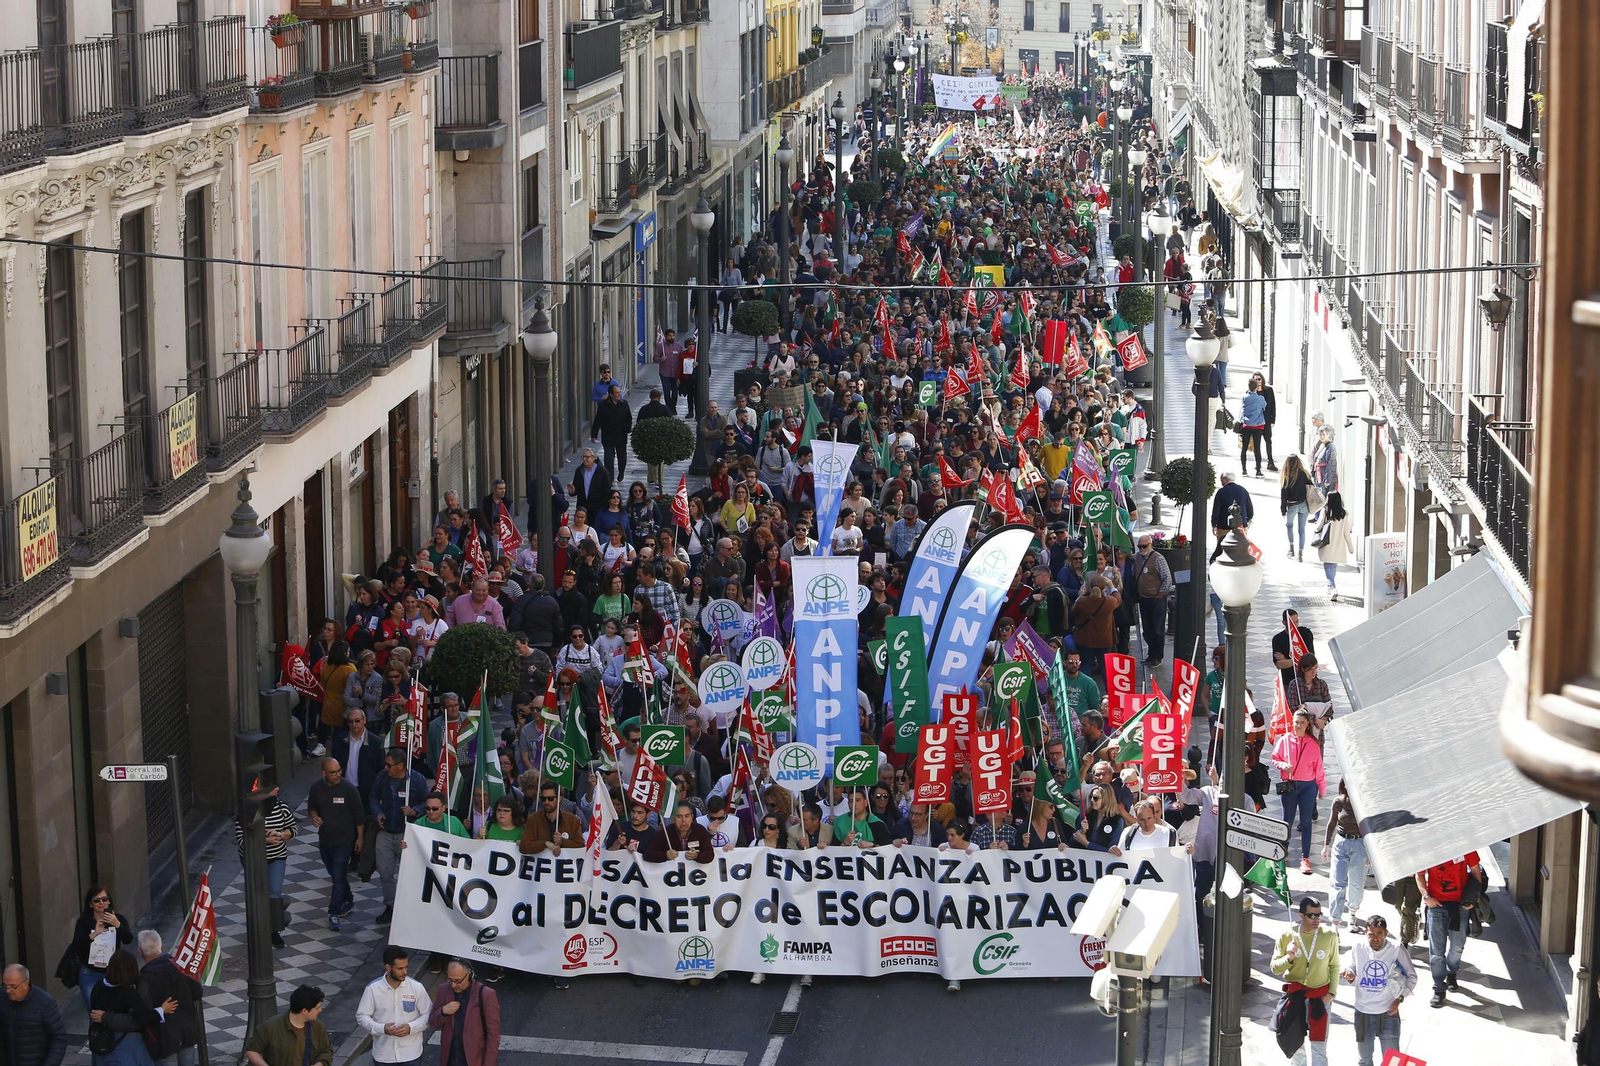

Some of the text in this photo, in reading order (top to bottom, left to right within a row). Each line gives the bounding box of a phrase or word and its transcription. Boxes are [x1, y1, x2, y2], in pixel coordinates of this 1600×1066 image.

[941, 79, 994, 89] CEIP GENIL
[171, 396, 195, 432] ALQUILER
[177, 425, 191, 446] EDIFICIO
[1115, 458, 1133, 466] CSIF
[22, 482, 55, 525] ALQUILER
[1089, 502, 1110, 511] CSIF
[29, 515, 50, 541] EDIFICIO
[24, 530, 57, 577] 696 470 900
[924, 545, 956, 562] ANPE
[1390, 550, 1404, 558] HOT
[972, 566, 1008, 583] ANPE
[803, 600, 850, 614] ANPE
[708, 620, 741, 632] ANPE
[746, 664, 781, 681] ANPE
[1003, 676, 1027, 689] CSIF
[1113, 657, 1131, 709] UGT
[705, 687, 745, 705] ANPE
[811, 628, 843, 764] ANPE
[1176, 665, 1196, 721] UGT
[949, 698, 970, 751] UGT
[650, 739, 680, 751] CSIF
[1151, 717, 1175, 771] UGT
[924, 728, 948, 782] UGT
[977, 733, 1003, 790] UGT
[551, 755, 571, 772] CSIF
[842, 760, 874, 771] CSIF
[776, 770, 821, 781] ANPE
[1245, 817, 1285, 831] Centro Comercial
[1229, 834, 1235, 844] C/
[1268, 830, 1285, 838] Granada
[430, 839, 473, 871] En
[664, 862, 707, 887] de
[718, 857, 753, 883] la
[766, 850, 991, 886] ENSEÑANZA
[1003, 851, 1164, 886] PÚBLICA
[421, 866, 498, 921] NO
[512, 892, 546, 929] al
[564, 892, 743, 934] DECRETO
[755, 887, 802, 926] de
[472, 945, 502, 955] ESTUDIANTES
[783, 941, 833, 955] FAMPA
[883, 938, 926, 954] CCOO
[981, 945, 1020, 961] CSIF
[1084, 941, 1106, 953] FRENT
[480, 951, 502, 959] MOVIMIENTO
[783, 954, 833, 962] ALHAMBRA
[881, 956, 939, 969] enseñanza
[675, 959, 715, 971] ANPE
